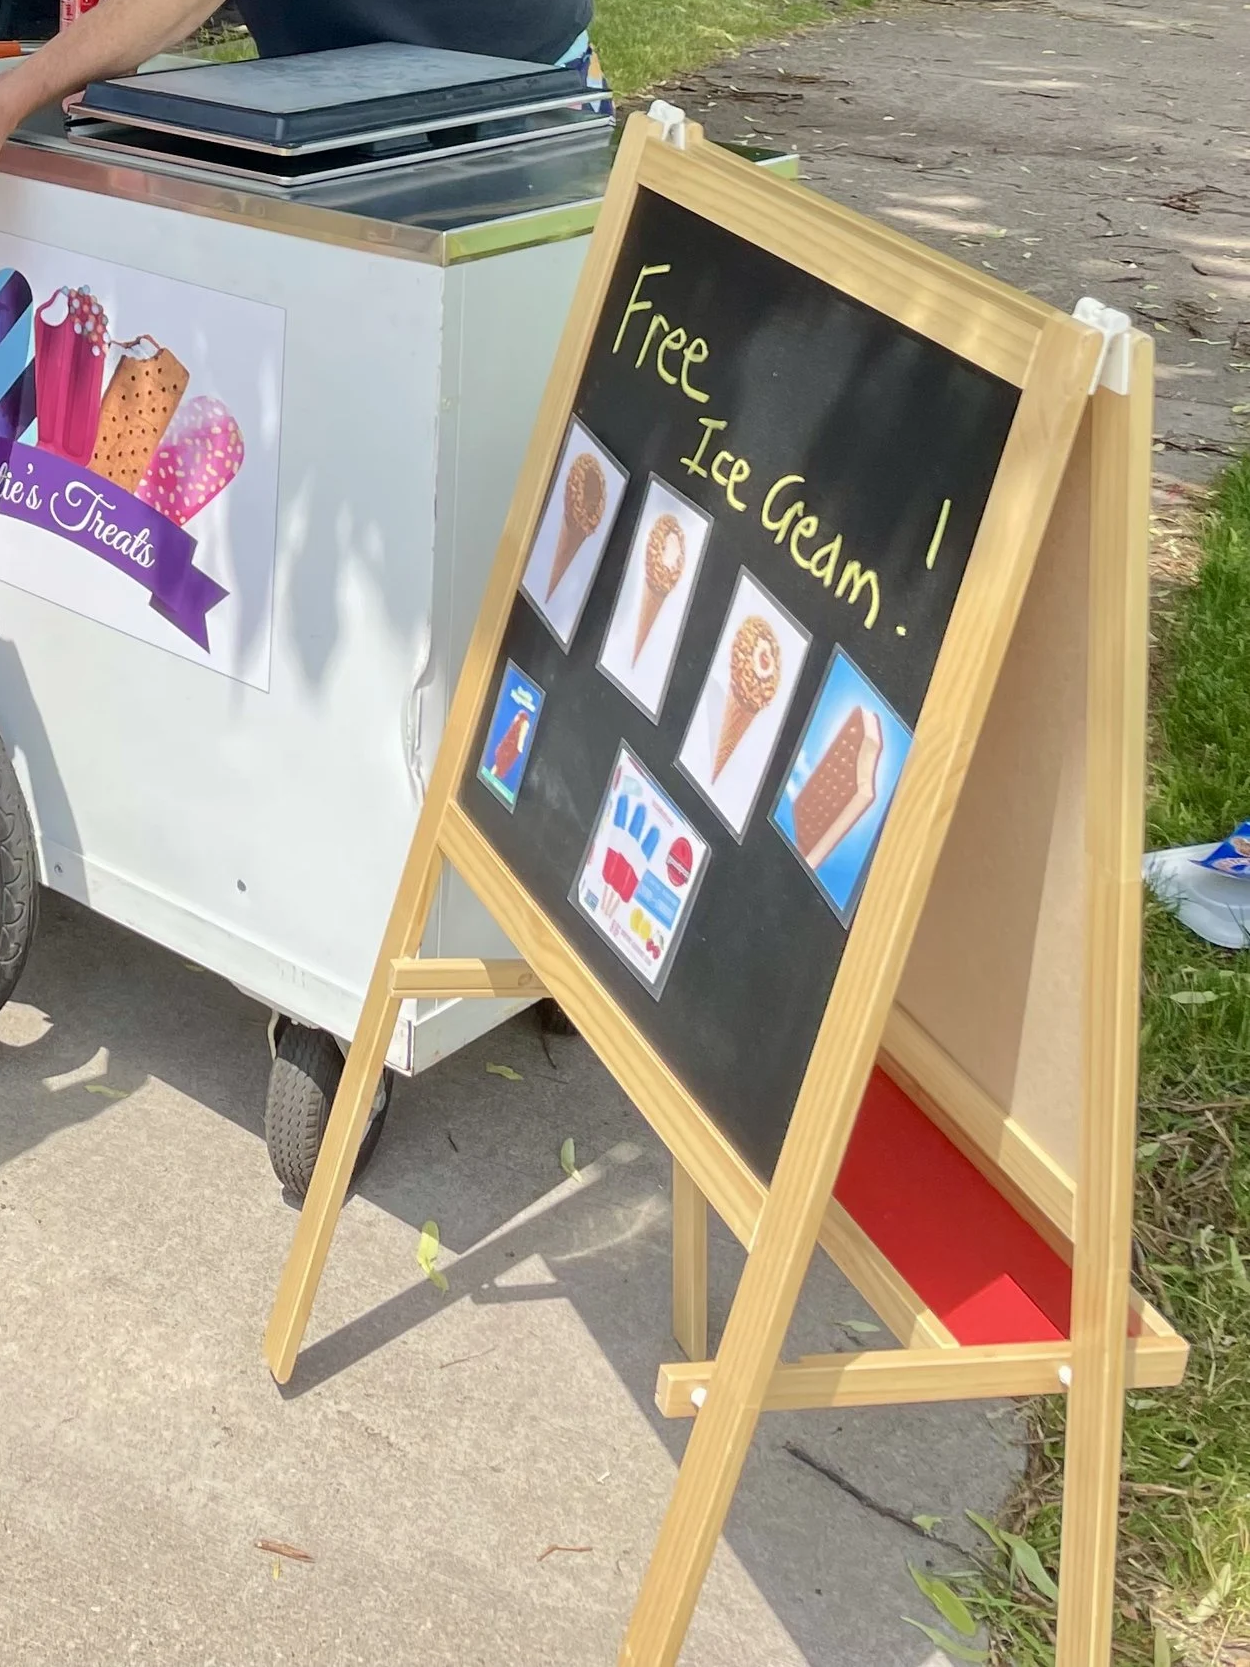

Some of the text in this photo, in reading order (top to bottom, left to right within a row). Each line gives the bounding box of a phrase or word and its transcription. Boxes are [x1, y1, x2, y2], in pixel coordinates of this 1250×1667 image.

[612, 263, 710, 404] Free
[679, 417, 751, 512] Ice
[50, 480, 156, 568] Treats
